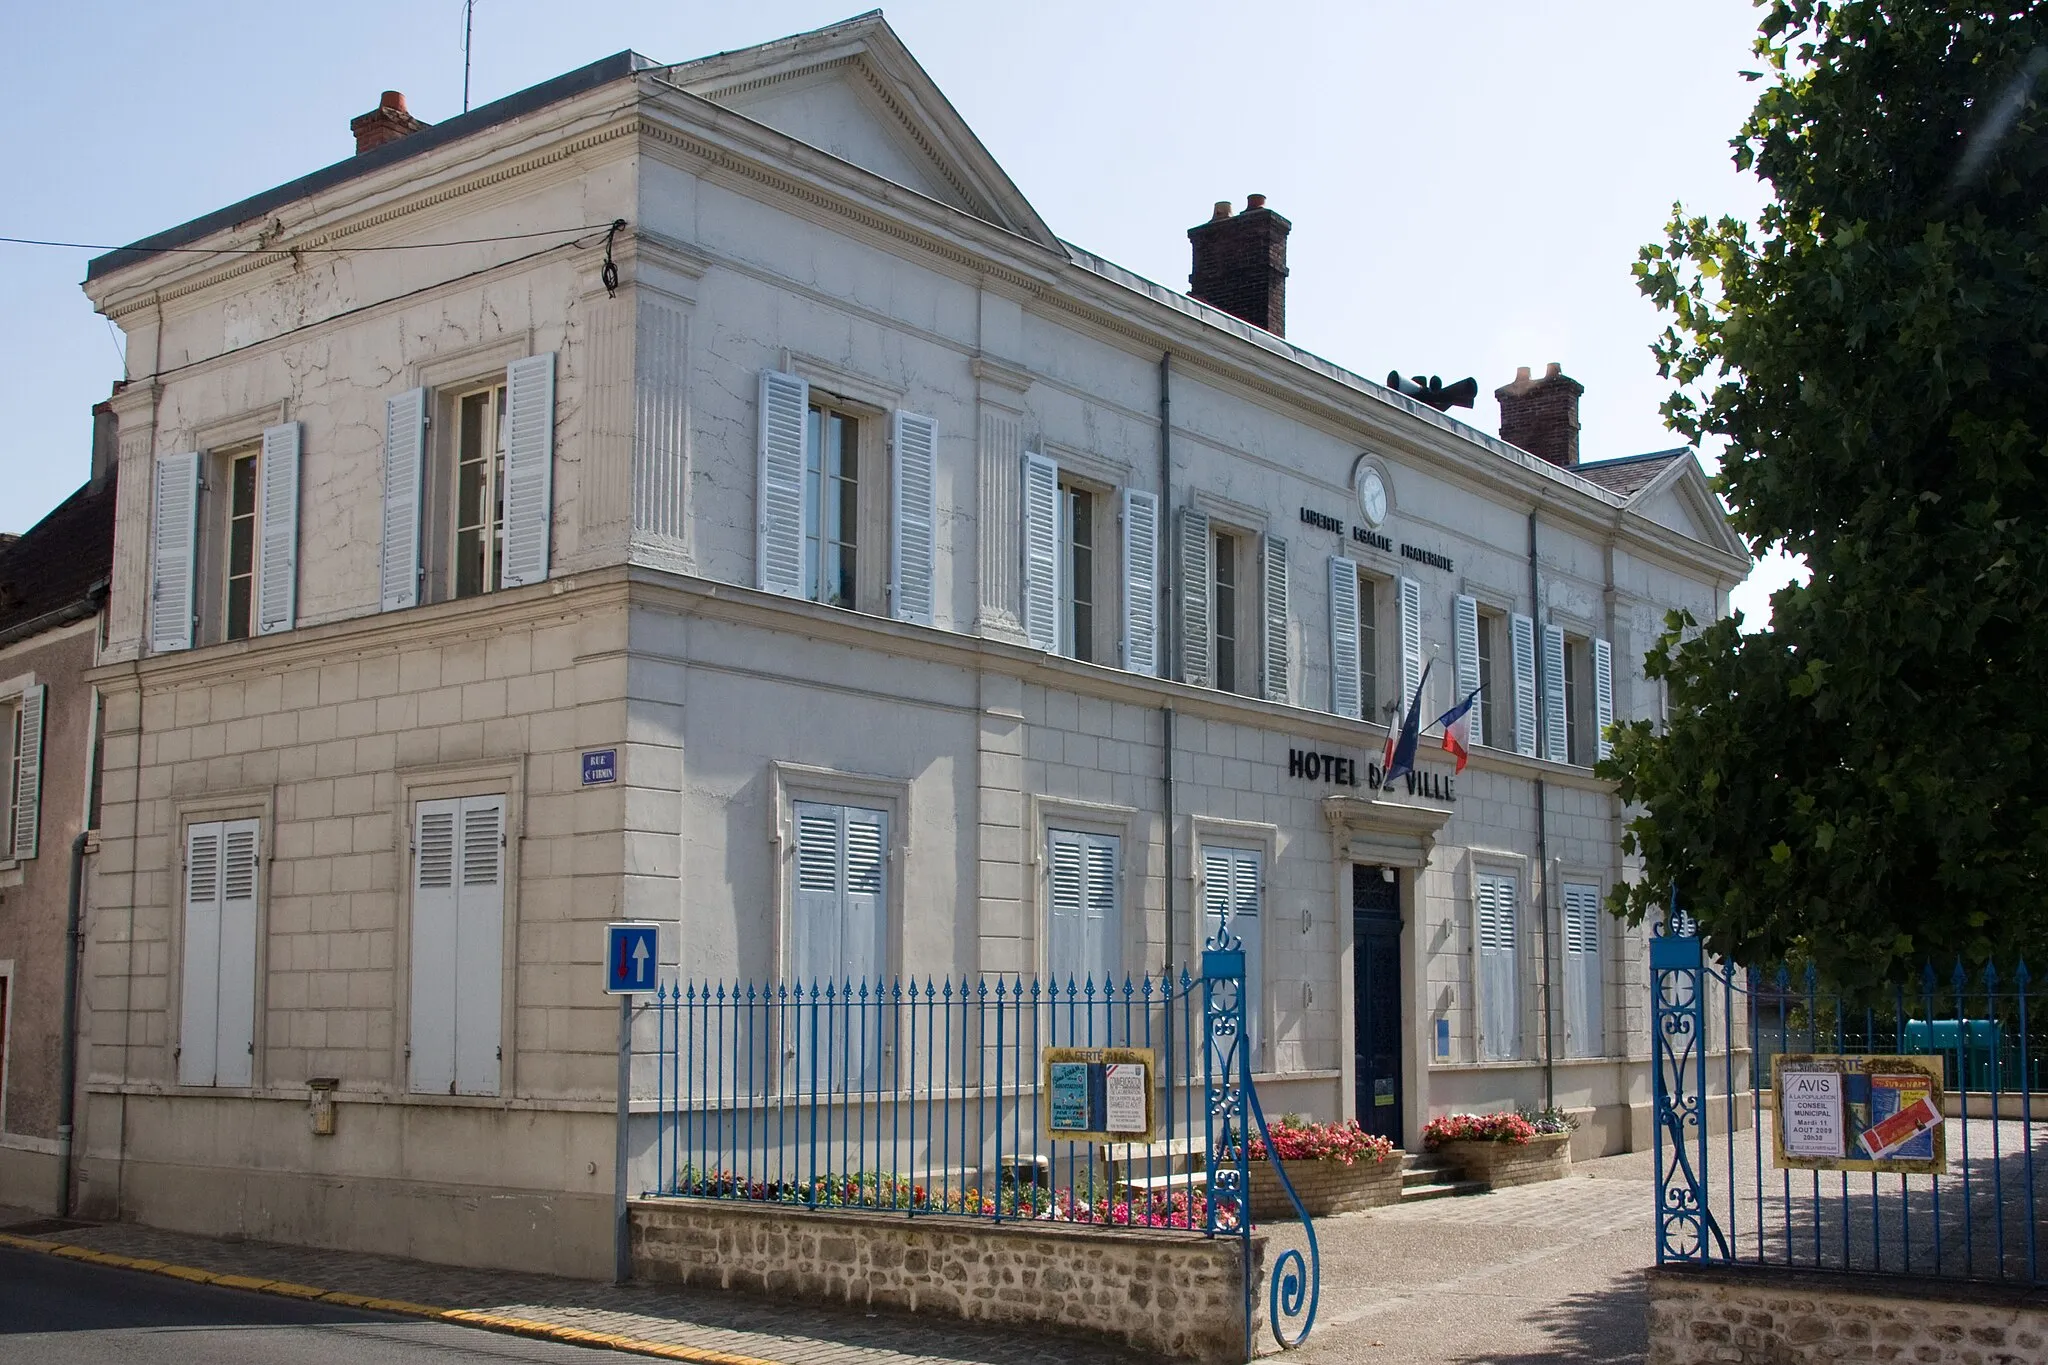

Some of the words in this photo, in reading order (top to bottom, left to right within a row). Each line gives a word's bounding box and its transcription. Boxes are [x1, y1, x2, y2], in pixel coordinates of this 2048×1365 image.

[1300, 507, 1344, 535] LIBERTE
[1353, 526, 1392, 552] EGALITE
[1401, 543, 1454, 572] FRATERNITE
[590, 755, 605, 766] RUE
[1289, 748, 1359, 787] HOTEL
[1406, 769, 1456, 800] VILLE
[1798, 1079, 1830, 1092] AVIS
